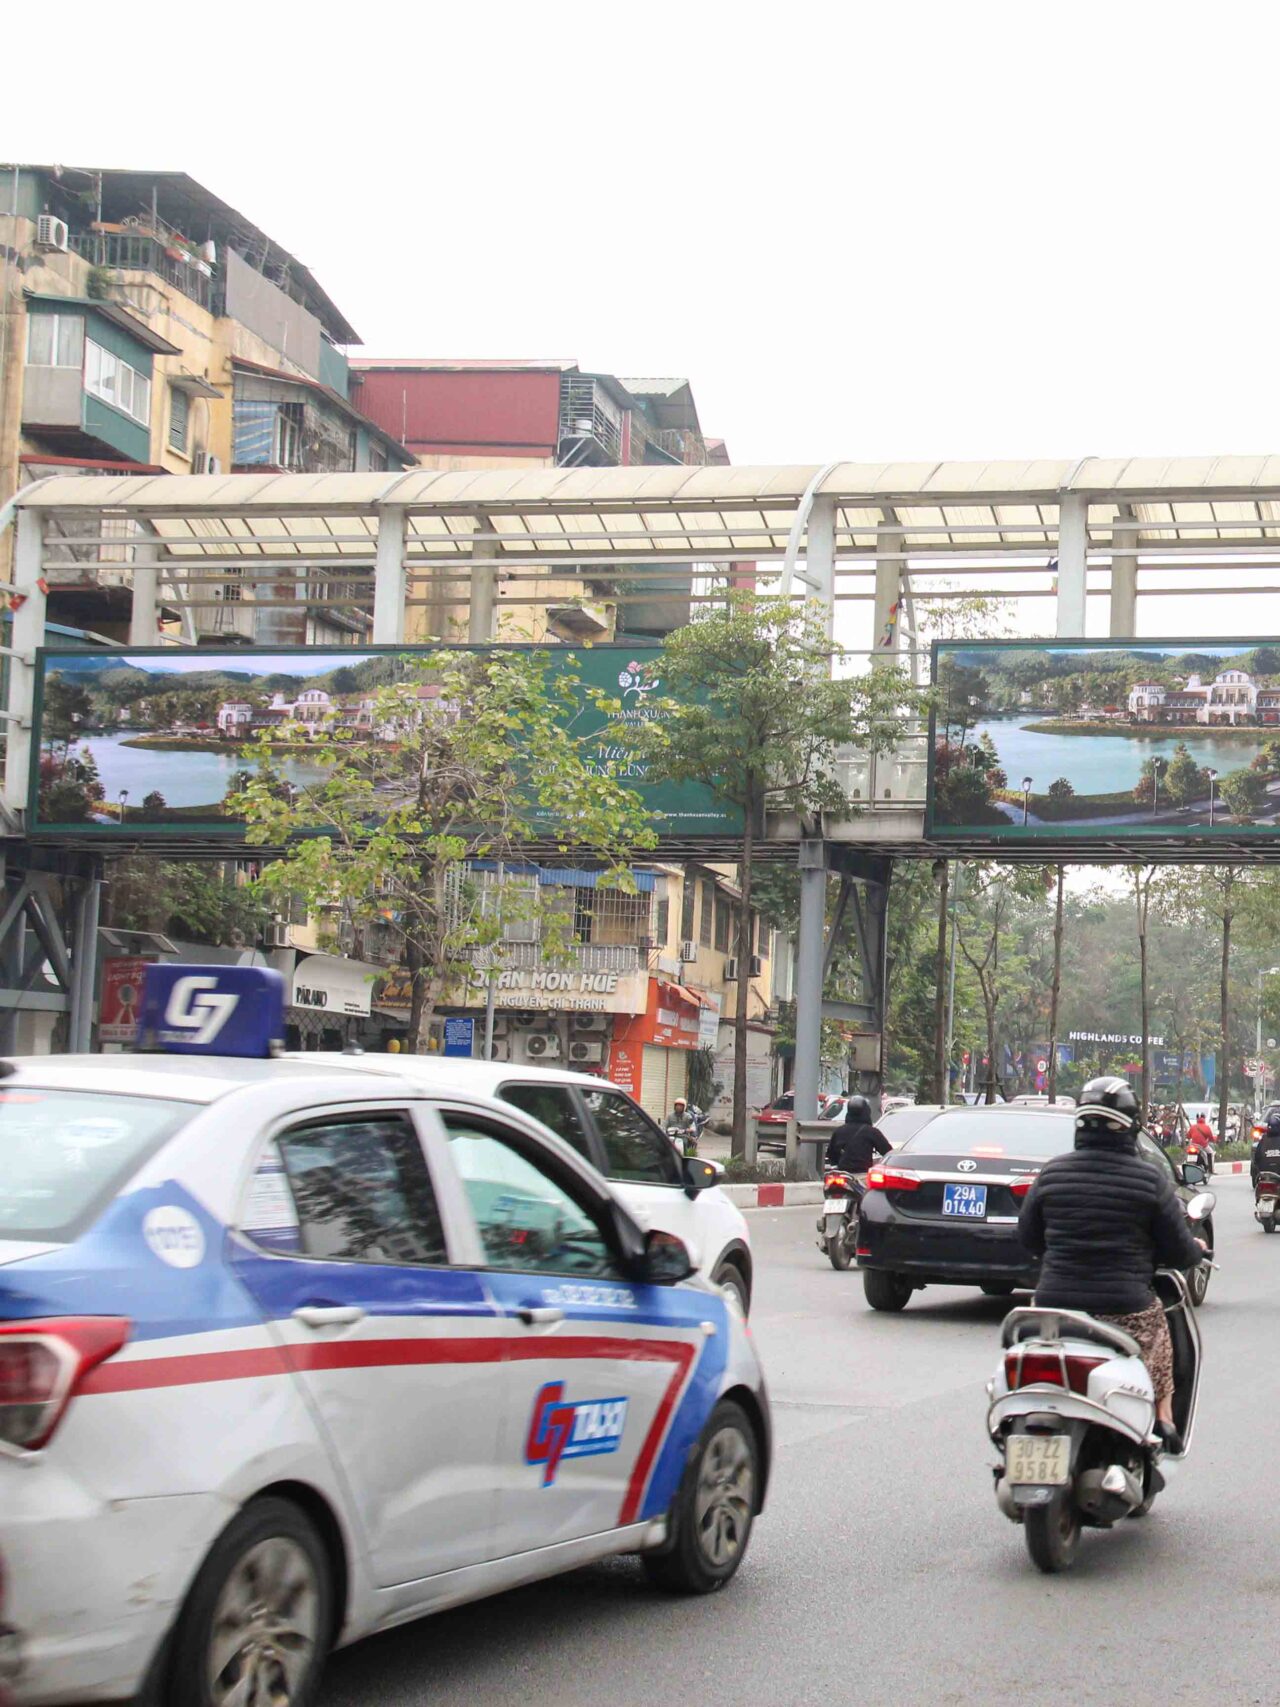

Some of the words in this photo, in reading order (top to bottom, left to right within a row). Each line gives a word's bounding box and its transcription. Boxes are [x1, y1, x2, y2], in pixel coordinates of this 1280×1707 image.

[164, 975, 240, 1045] G7
[1069, 1031, 1127, 1043] HIGHLANDS
[1129, 1035, 1164, 1046] COFEE
[954, 1186, 976, 1201] 29A
[944, 1200, 984, 1215] 014.40
[1014, 1460, 1059, 1481] 9584
